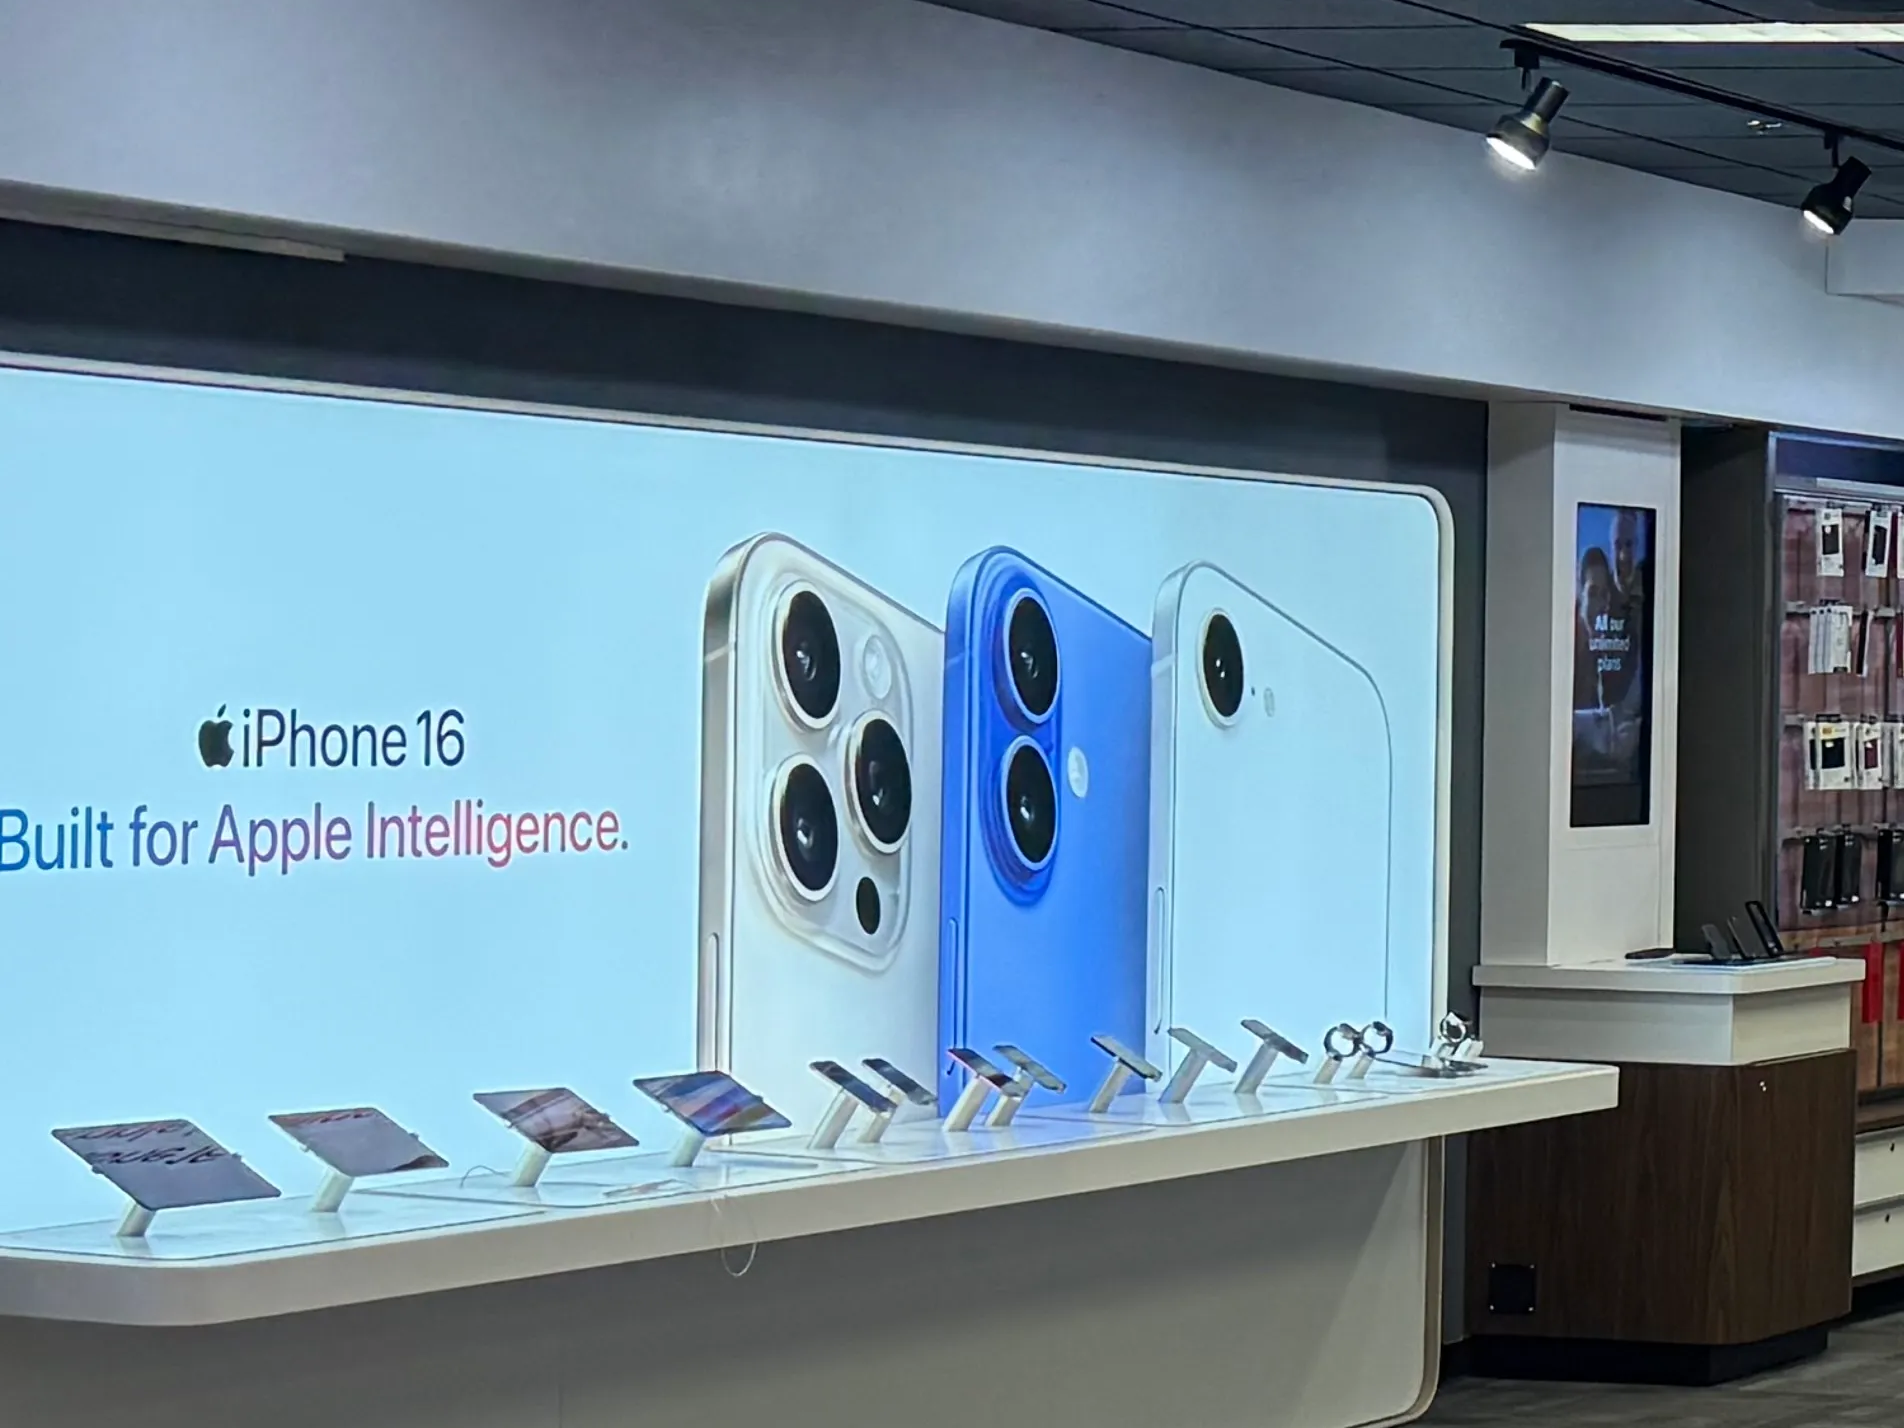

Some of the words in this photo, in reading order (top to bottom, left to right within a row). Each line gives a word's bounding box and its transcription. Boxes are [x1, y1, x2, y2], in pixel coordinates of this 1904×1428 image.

[242, 708, 407, 767] iPhone
[416, 709, 466, 767] 16
[0, 806, 114, 871] Built
[130, 804, 197, 866] for
[208, 803, 351, 877] Apple
[366, 799, 629, 868] Intelligence.
